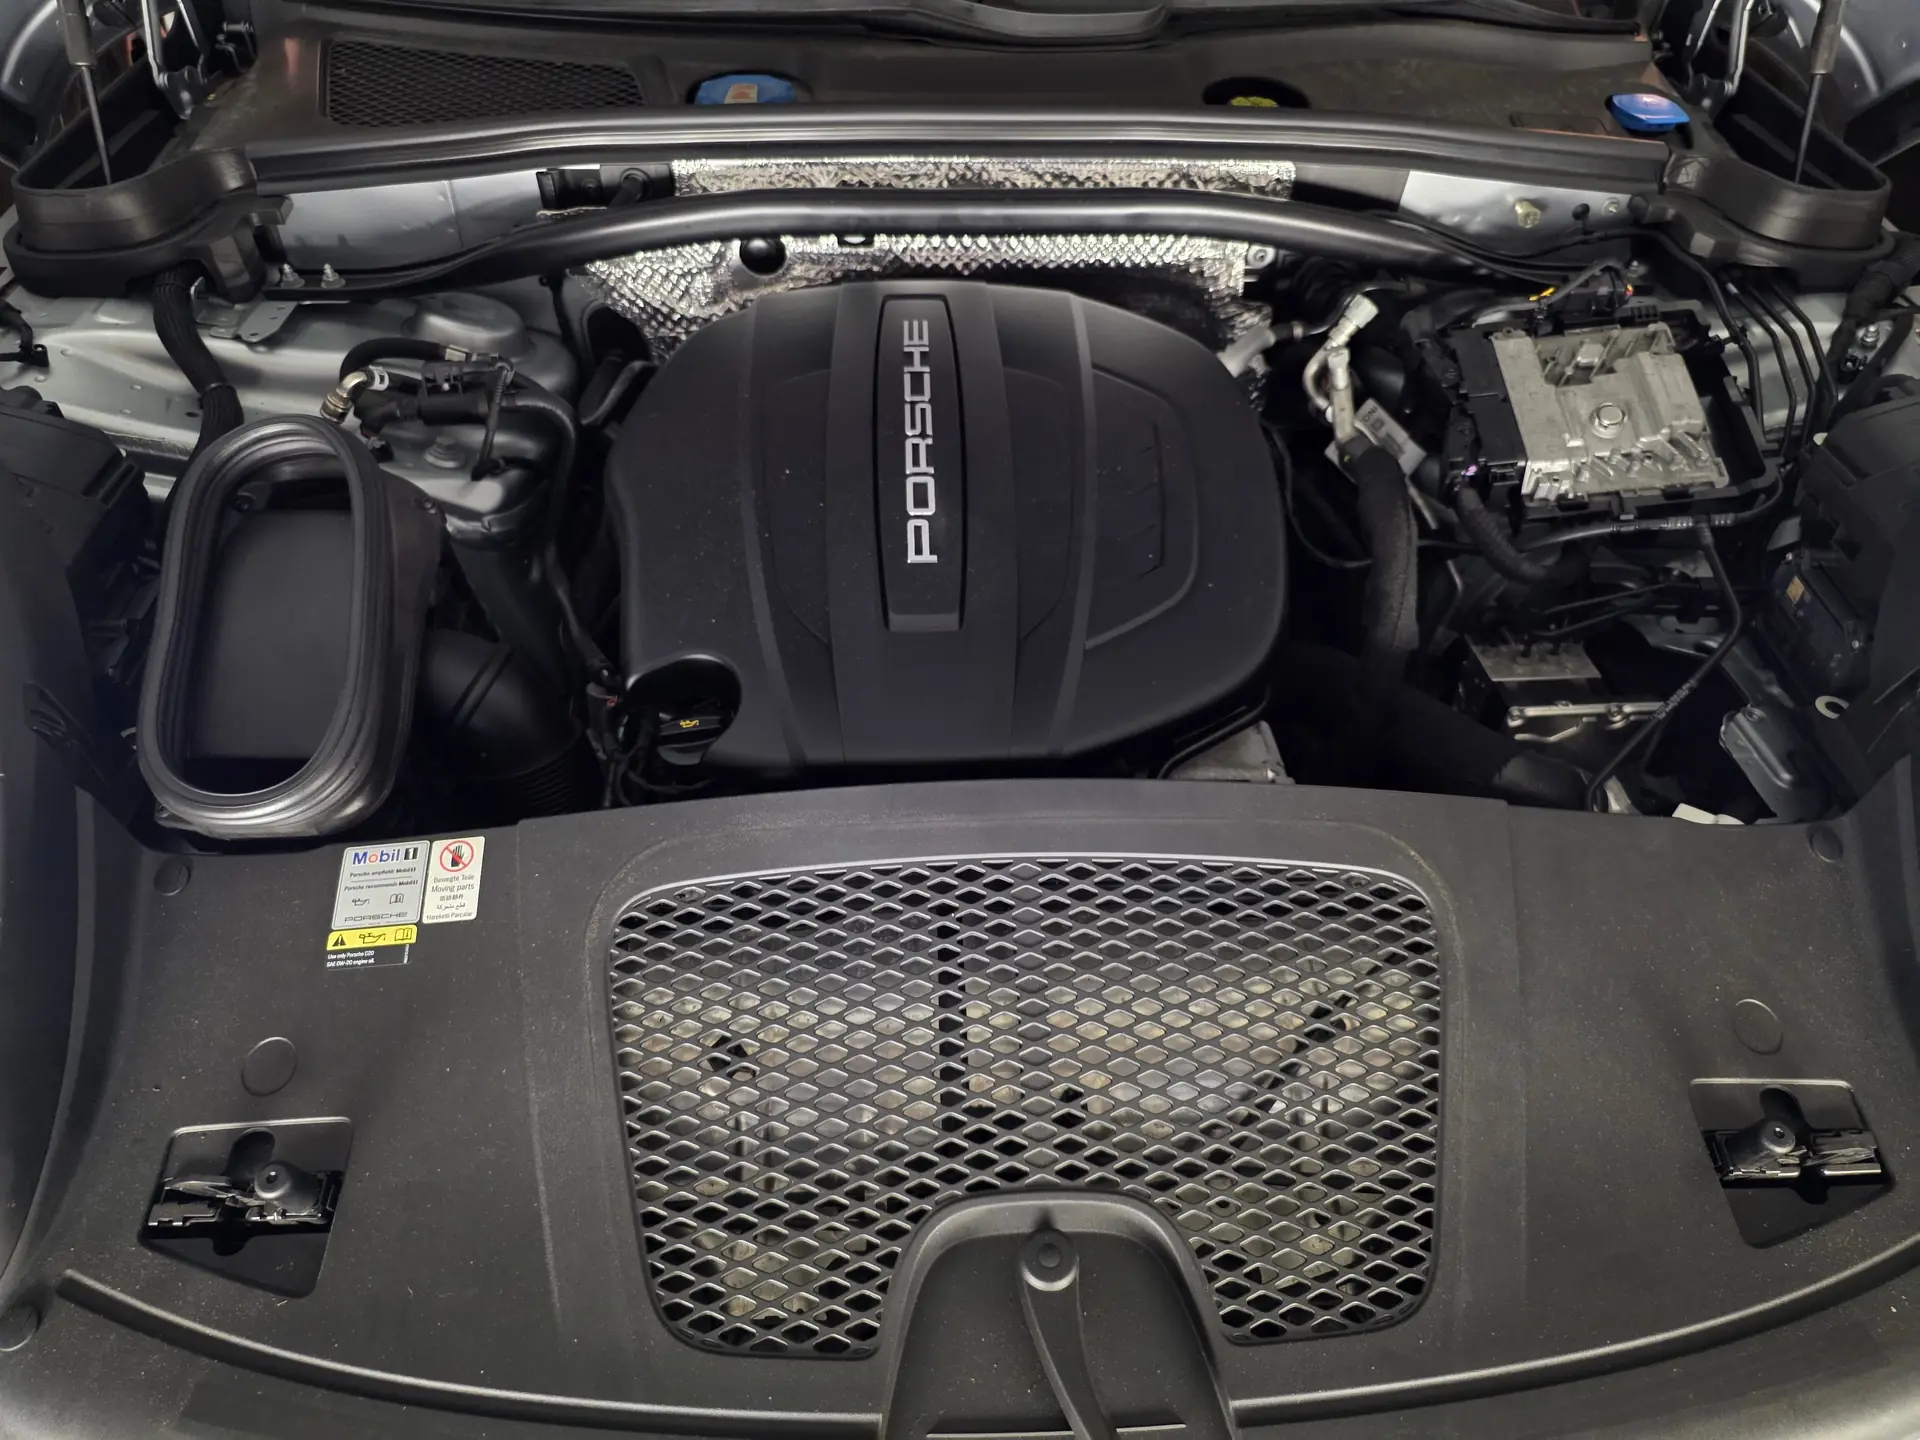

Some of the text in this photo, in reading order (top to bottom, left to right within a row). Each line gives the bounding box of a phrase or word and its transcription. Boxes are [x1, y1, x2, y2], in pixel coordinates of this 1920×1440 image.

[904, 320, 938, 563] PORSCHE
[352, 847, 419, 865] Mobil 1
[431, 884, 475, 893] Moving parts
[344, 911, 408, 923] PORSCHE
